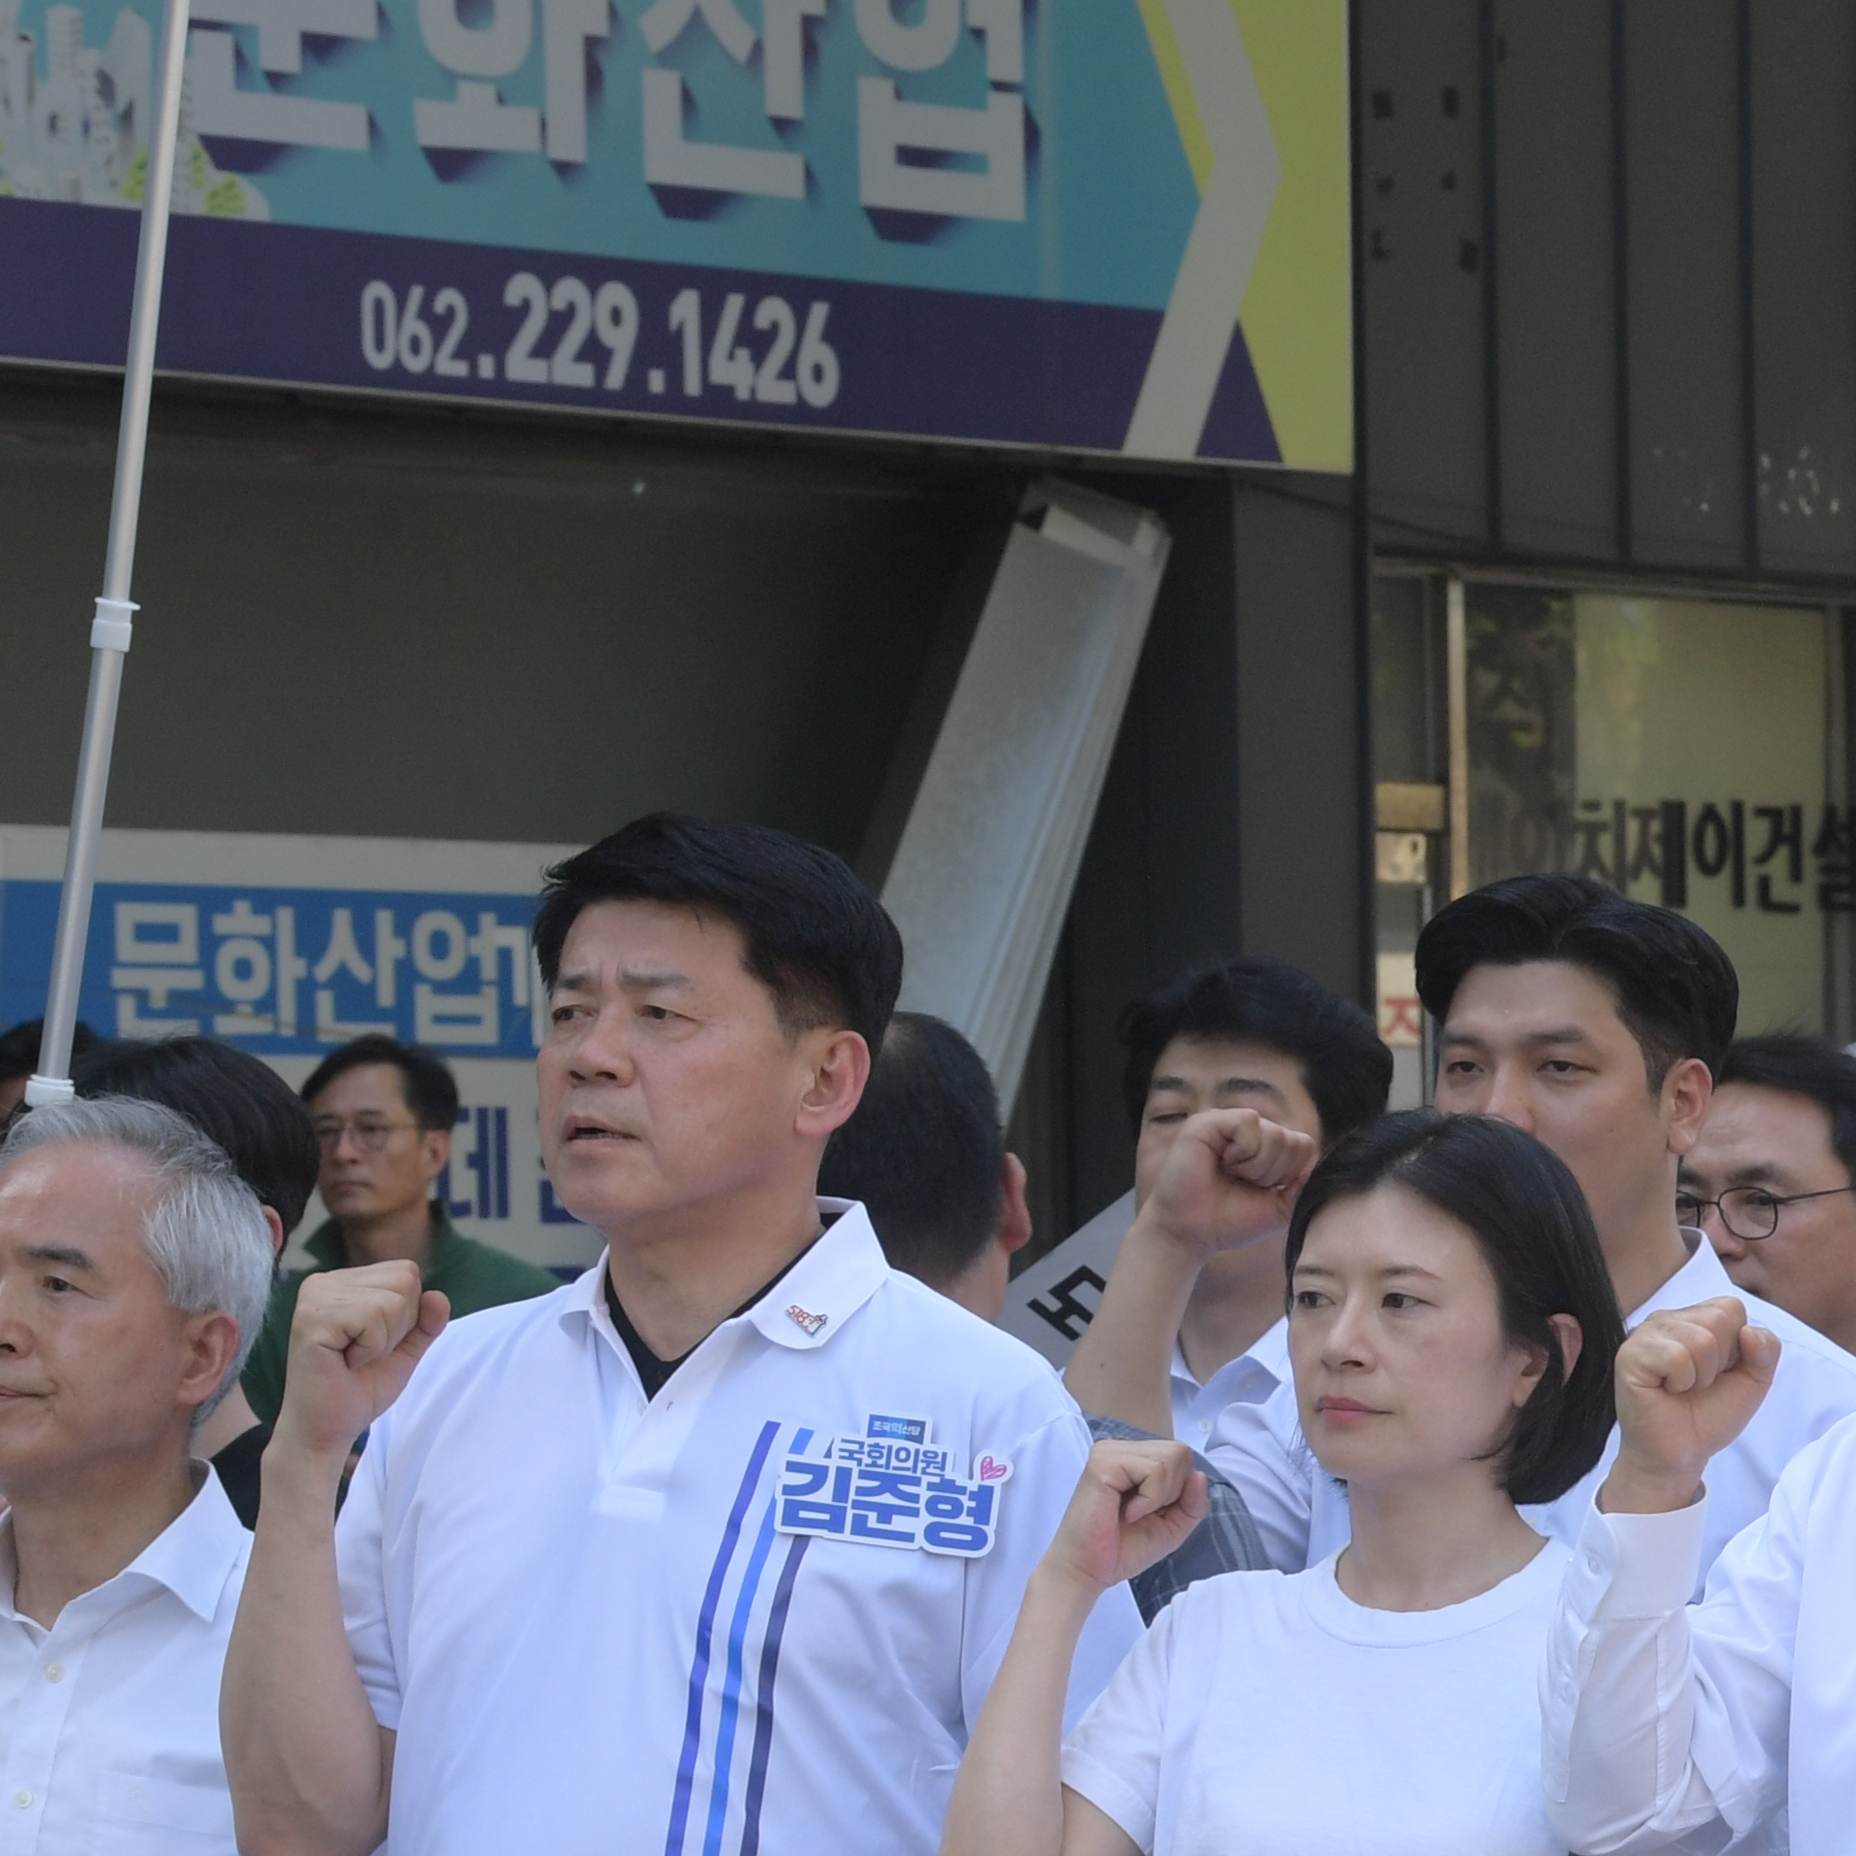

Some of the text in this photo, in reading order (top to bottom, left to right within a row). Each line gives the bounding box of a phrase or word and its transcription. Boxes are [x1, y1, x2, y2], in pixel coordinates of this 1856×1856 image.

[360, 271, 840, 408] 062.229.1426
[837, 1437, 948, 1478] 국회의원
[780, 1459, 995, 1552] 김준형
